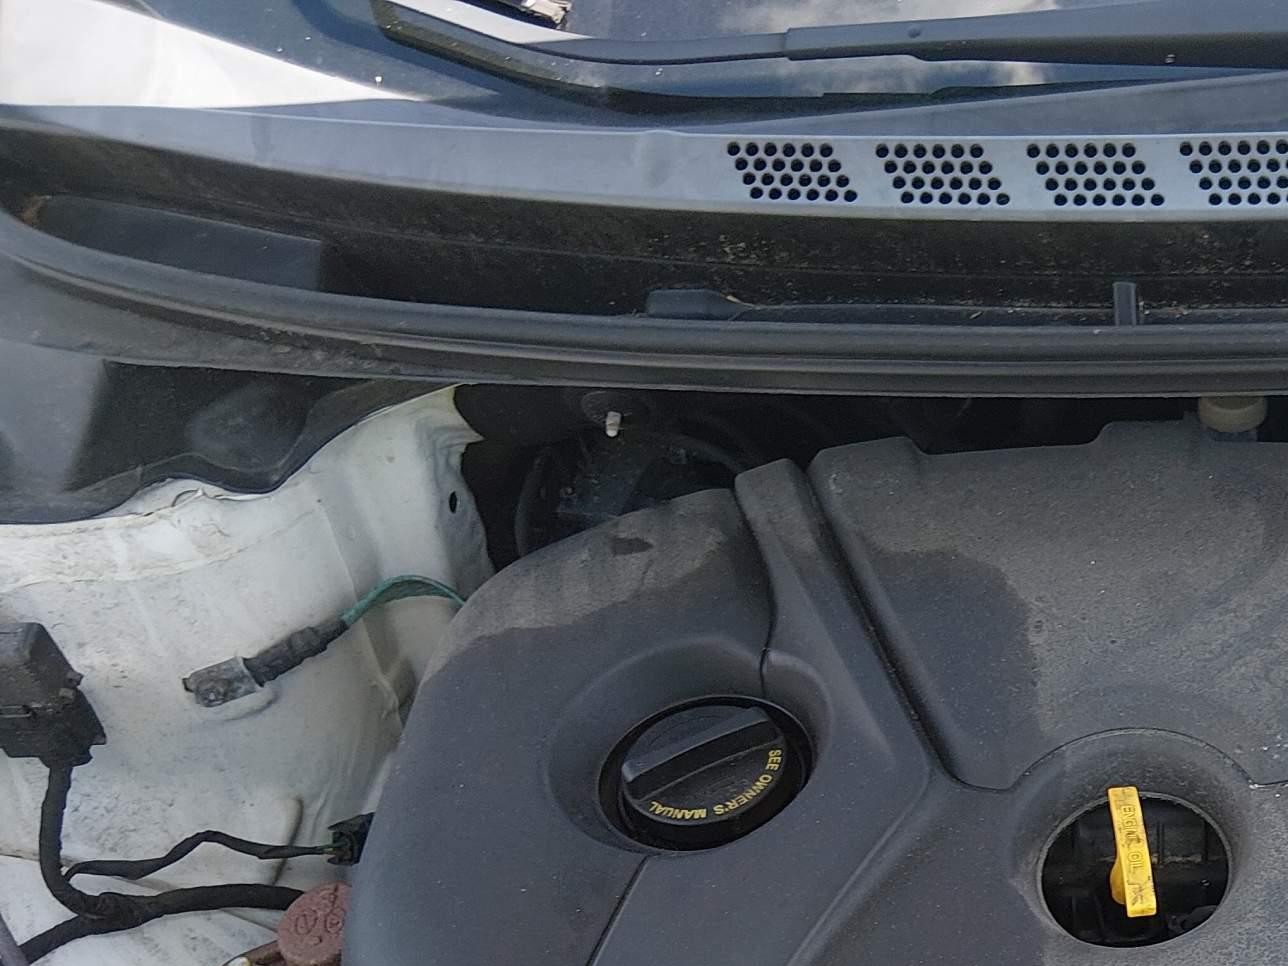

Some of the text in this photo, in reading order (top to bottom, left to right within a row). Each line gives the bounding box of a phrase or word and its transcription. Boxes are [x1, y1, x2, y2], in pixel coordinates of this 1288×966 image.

[649, 749, 782, 819] SEE OWNER'S MANUAL
[1127, 851, 1144, 874] OIL
